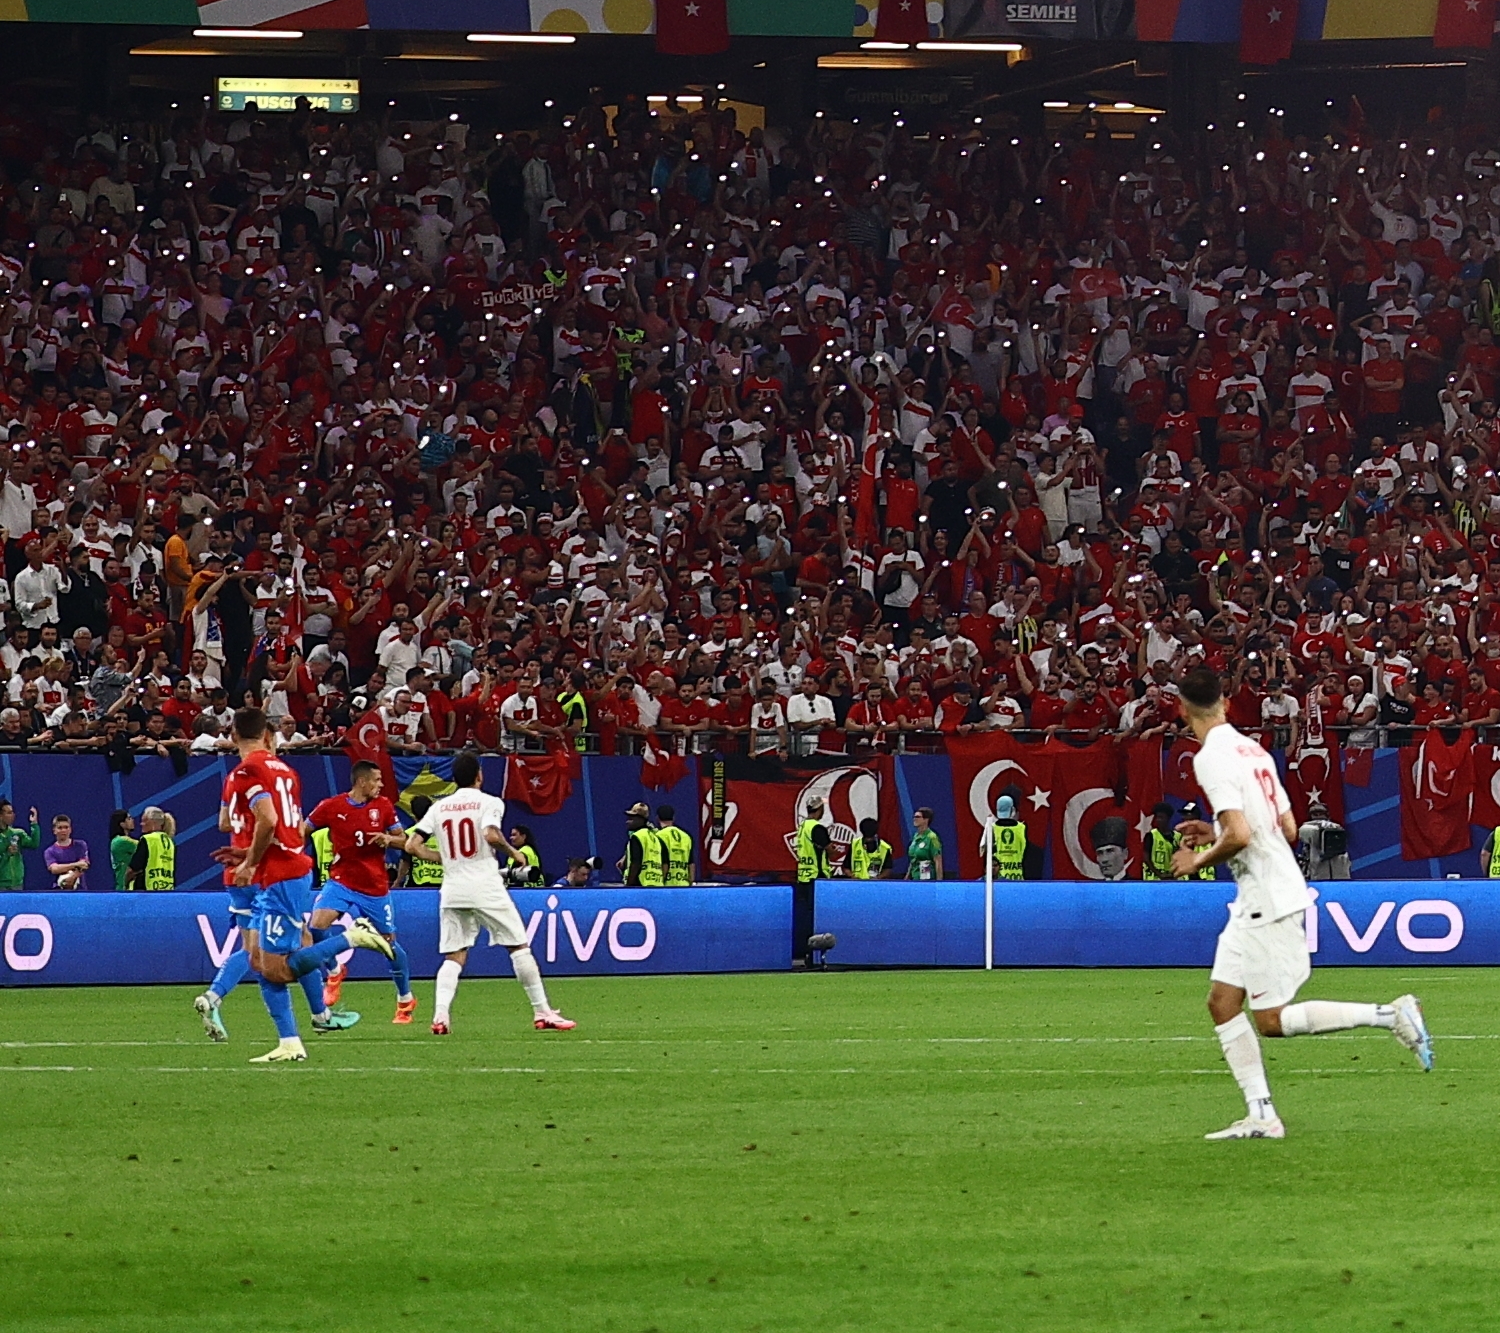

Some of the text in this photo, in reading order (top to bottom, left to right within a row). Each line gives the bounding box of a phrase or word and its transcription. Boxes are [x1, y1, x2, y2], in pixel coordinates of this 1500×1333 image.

[355, 829, 365, 847] 3
[441, 818, 479, 861] 10
[264, 913, 284, 937] 14
